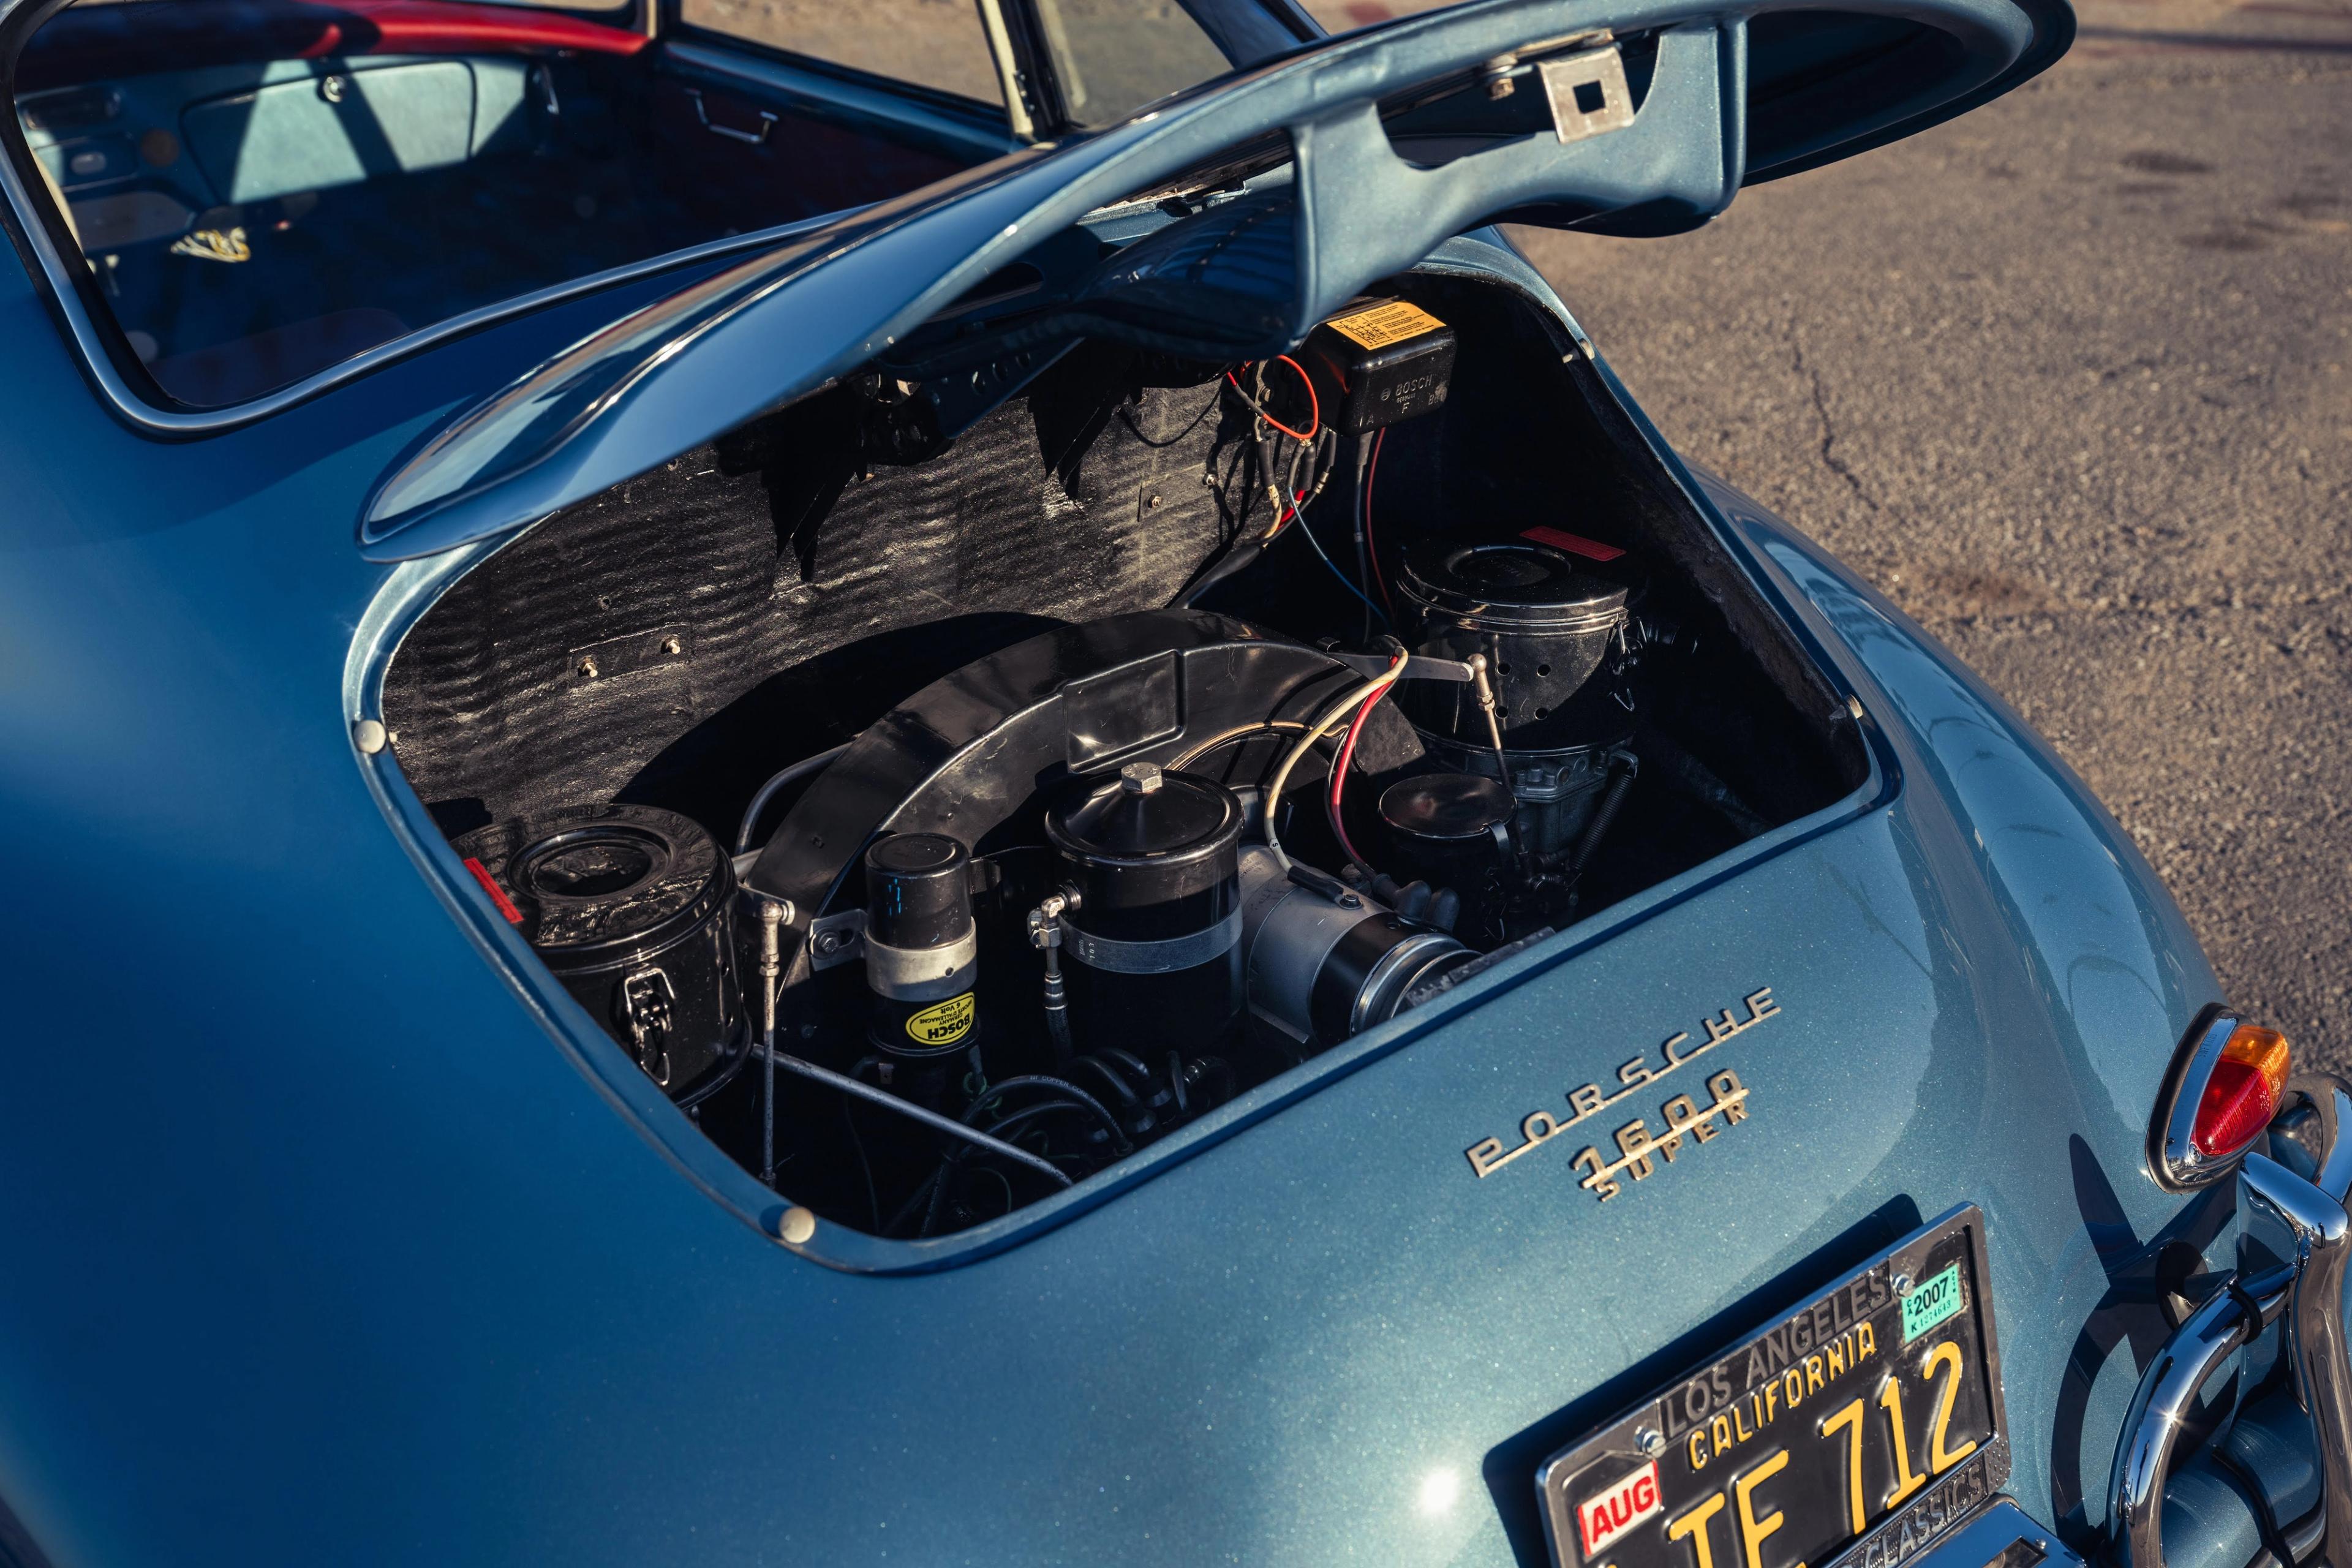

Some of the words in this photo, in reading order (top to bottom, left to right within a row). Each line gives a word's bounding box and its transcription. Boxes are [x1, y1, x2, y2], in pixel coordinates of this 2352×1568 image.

[1395, 374, 1433, 396] BOSCH
[1402, 402, 1409, 413] F
[928, 1013, 970, 1039] BOSCH
[938, 1012, 963, 1025] GERMANY
[940, 1004, 955, 1014] Volt
[1042, 1075, 1069, 1088] COPPER
[1466, 987, 1782, 1178] PORSCHE
[1573, 1068, 1750, 1189] 1600
[1594, 1099, 1749, 1202] SUPER
[1907, 1298, 1913, 1316] CA
[1913, 1276, 1949, 1316] 2007
[1911, 1323, 1918, 1333] K
[1666, 1366, 1732, 1439] LOS
[1746, 1268, 1887, 1389] ANGELES
[1688, 1321, 1877, 1470] CALIFORNIA
[1822, 1340, 1977, 1535] 712
[1592, 1475, 1655, 1544] AUG
[1864, 1464, 1981, 1568] CLASSICS
